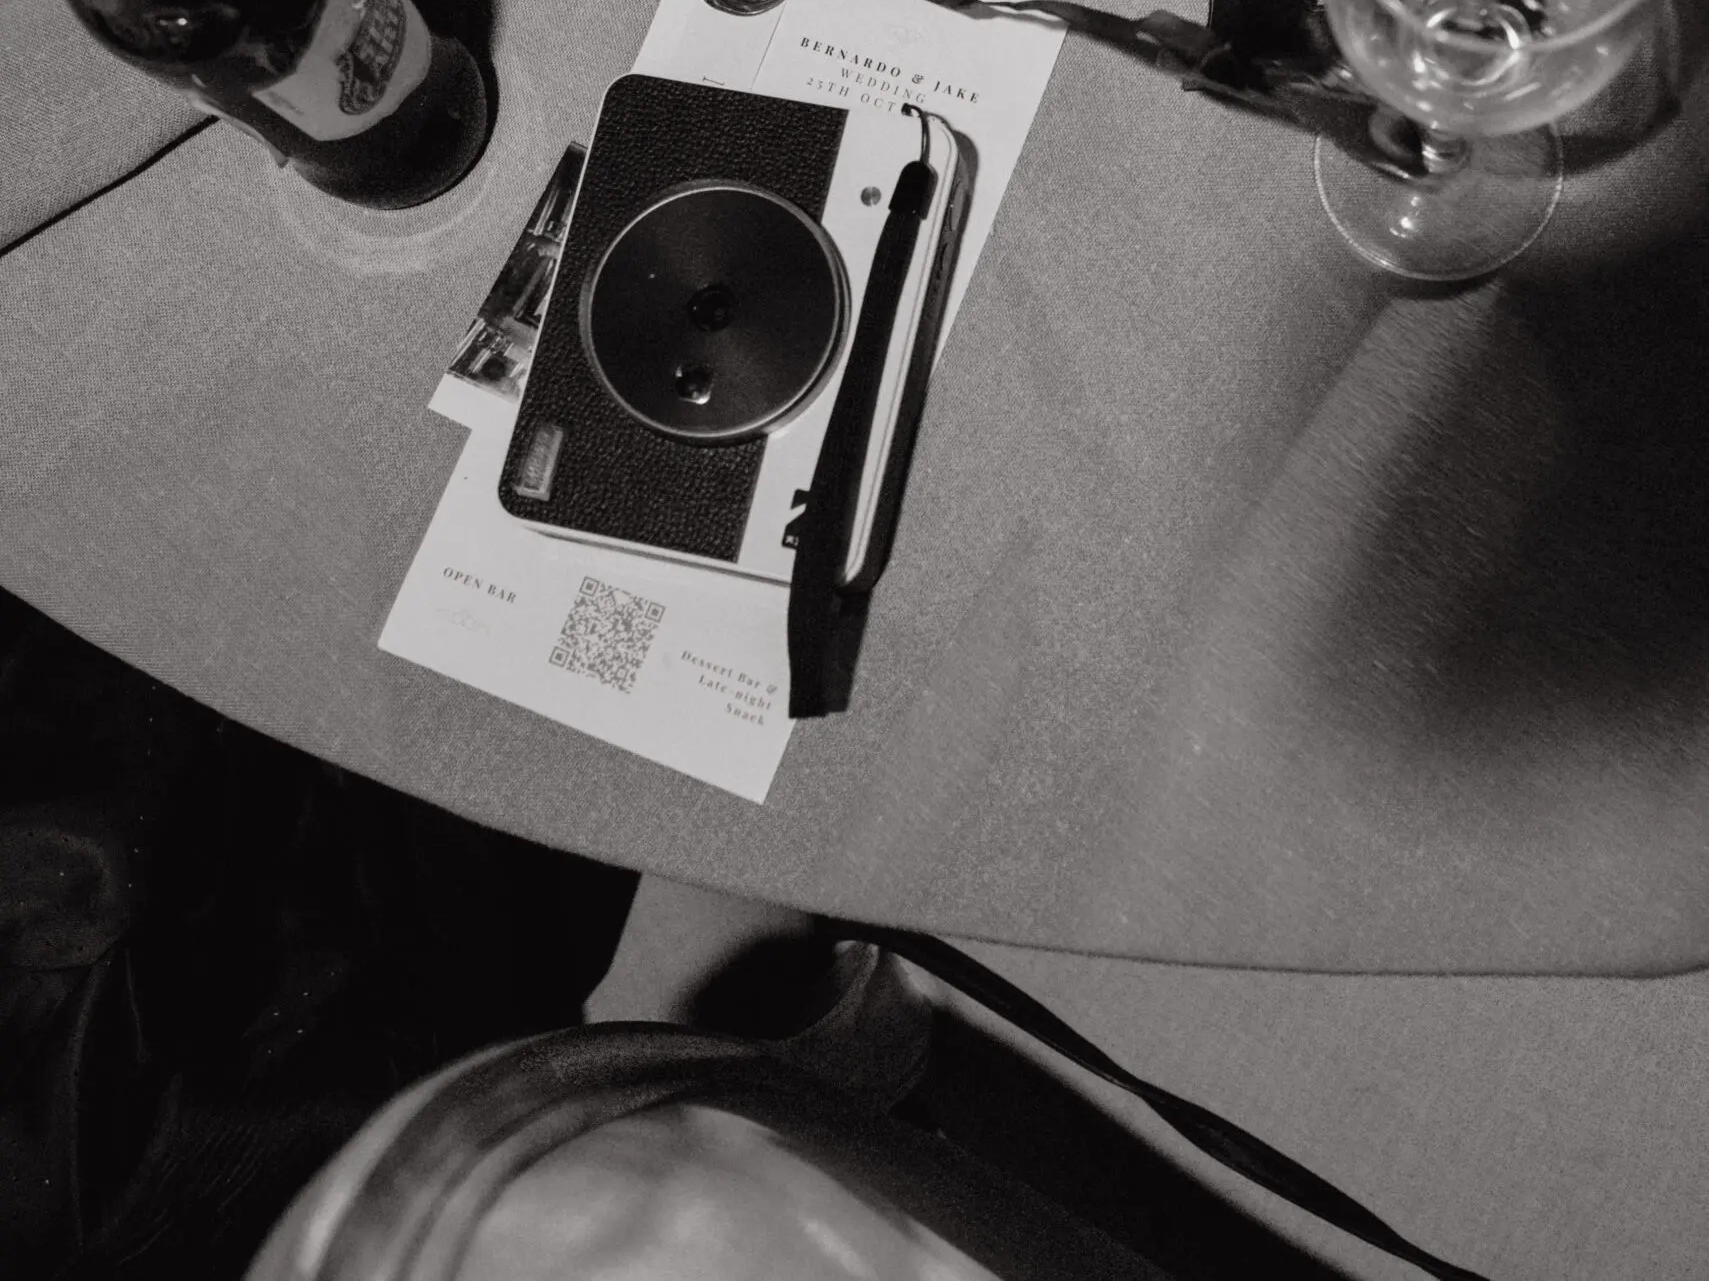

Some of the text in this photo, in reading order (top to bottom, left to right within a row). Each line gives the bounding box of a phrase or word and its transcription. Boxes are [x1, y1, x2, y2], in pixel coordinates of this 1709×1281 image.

[799, 36, 981, 105] BERNARDO & JAKE
[840, 67, 928, 105] WEDDING
[805, 76, 898, 113] 25TH OCT
[443, 566, 517, 604] OPEN BAR
[680, 649, 733, 679] Dessert
[737, 671, 761, 689] Bar
[725, 701, 765, 727] Snack
